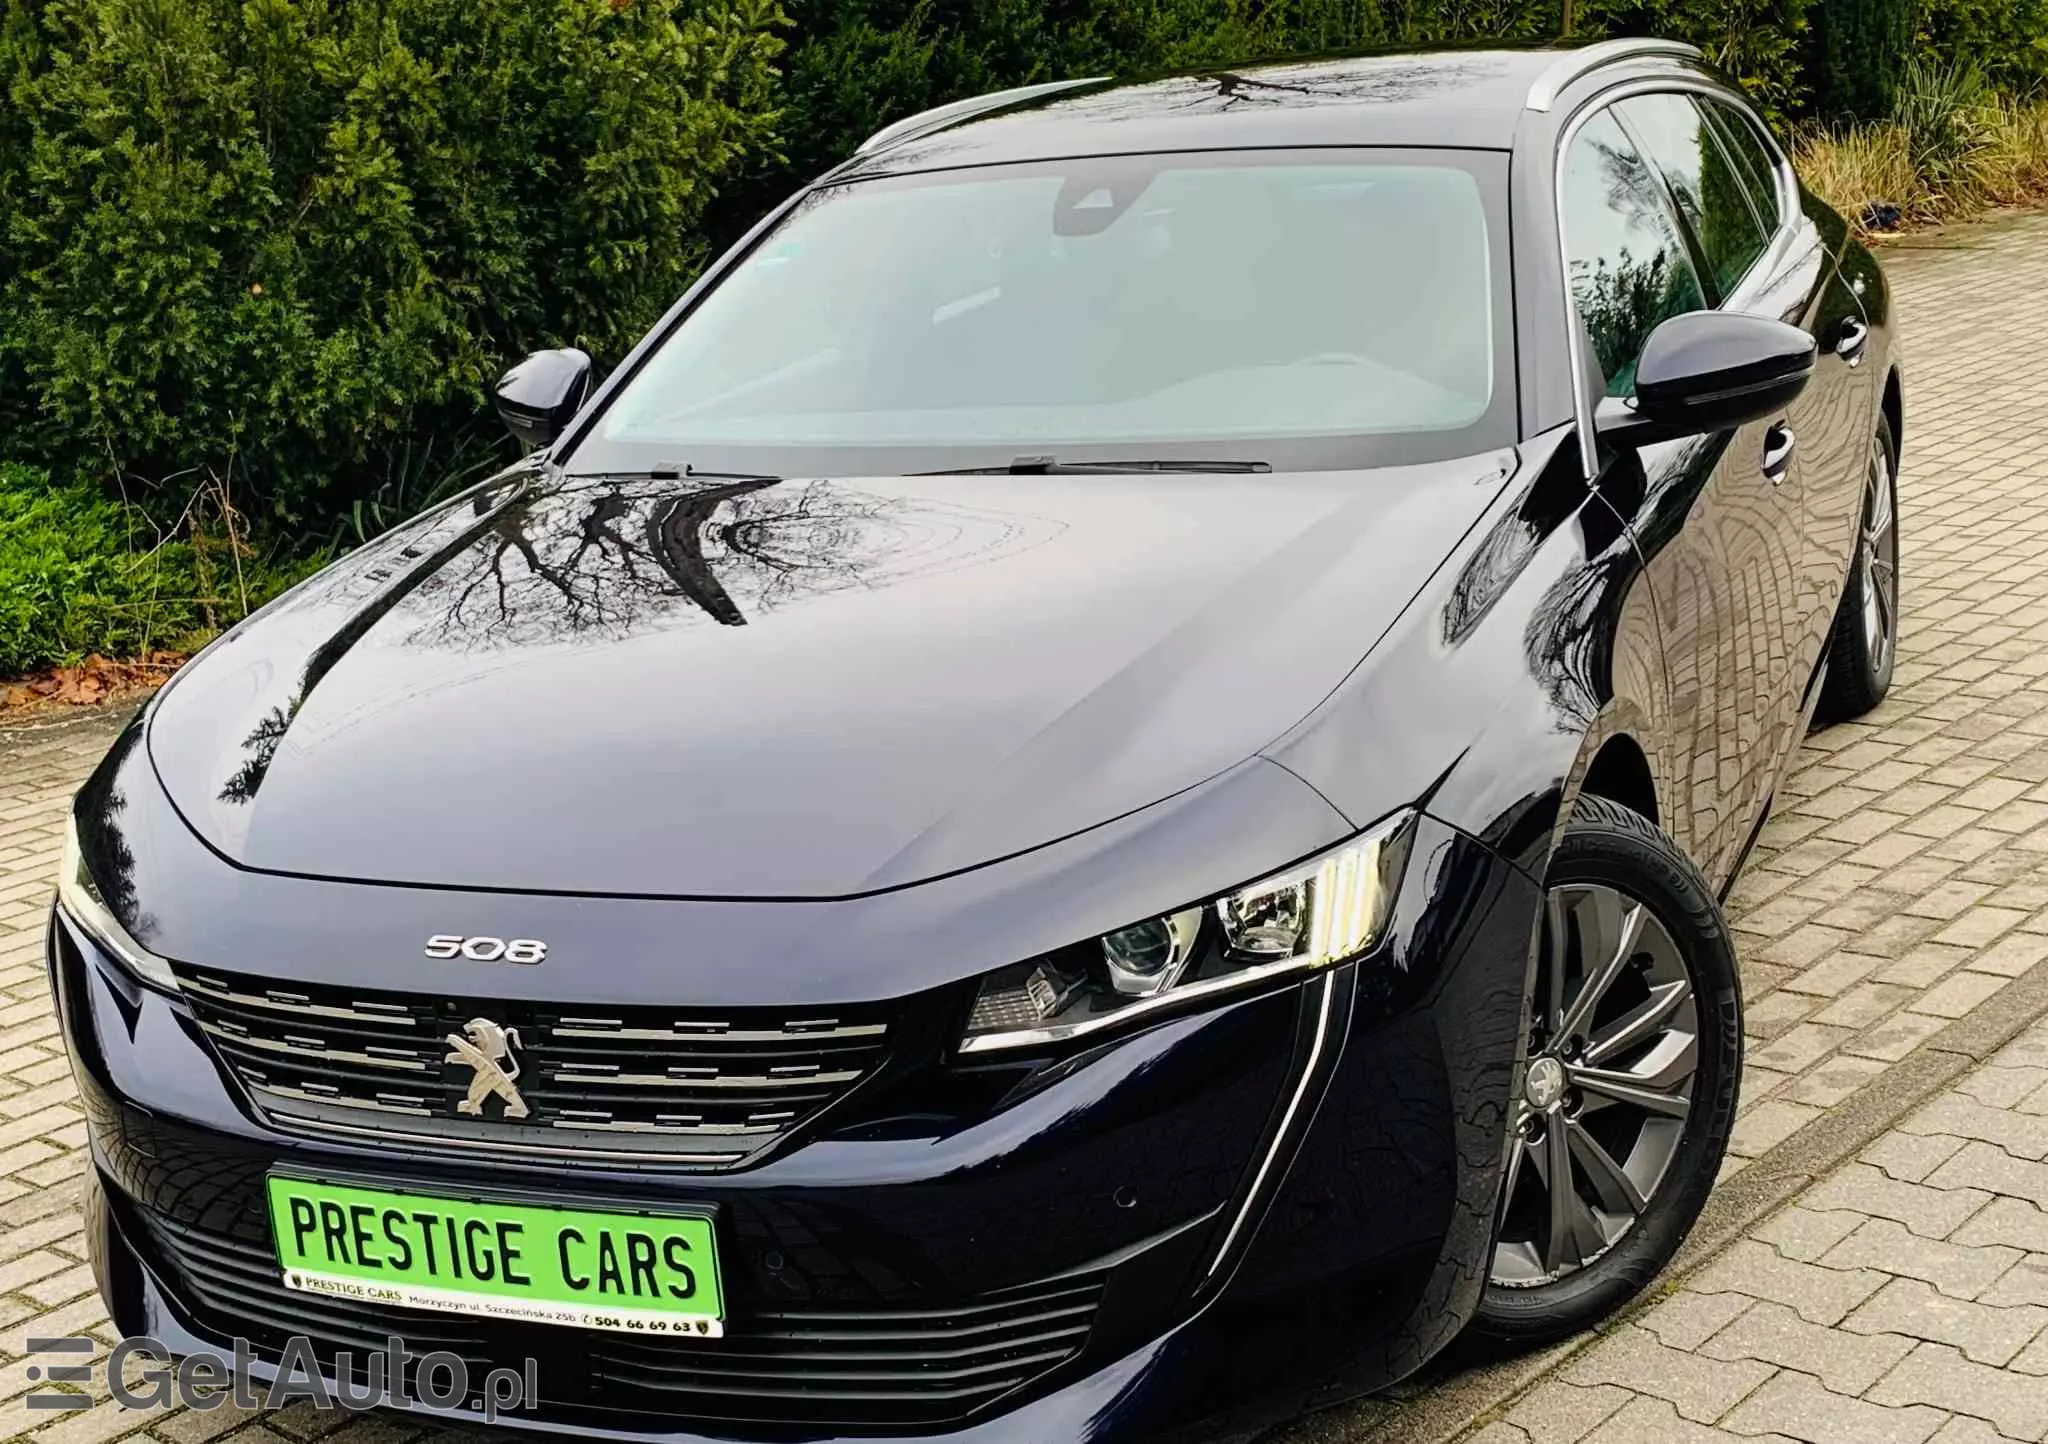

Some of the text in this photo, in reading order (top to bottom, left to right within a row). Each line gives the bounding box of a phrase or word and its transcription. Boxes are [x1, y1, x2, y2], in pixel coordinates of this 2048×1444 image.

[425, 934, 548, 965] 508
[288, 1196, 698, 1299] PRESTIGE CARS
[305, 1277, 365, 1296] PRESTIGE
[367, 1287, 402, 1301] CARS
[595, 1316, 621, 1328] 504
[626, 1319, 644, 1330] 66
[650, 1320, 666, 1331] 69
[672, 1322, 691, 1333] 63
